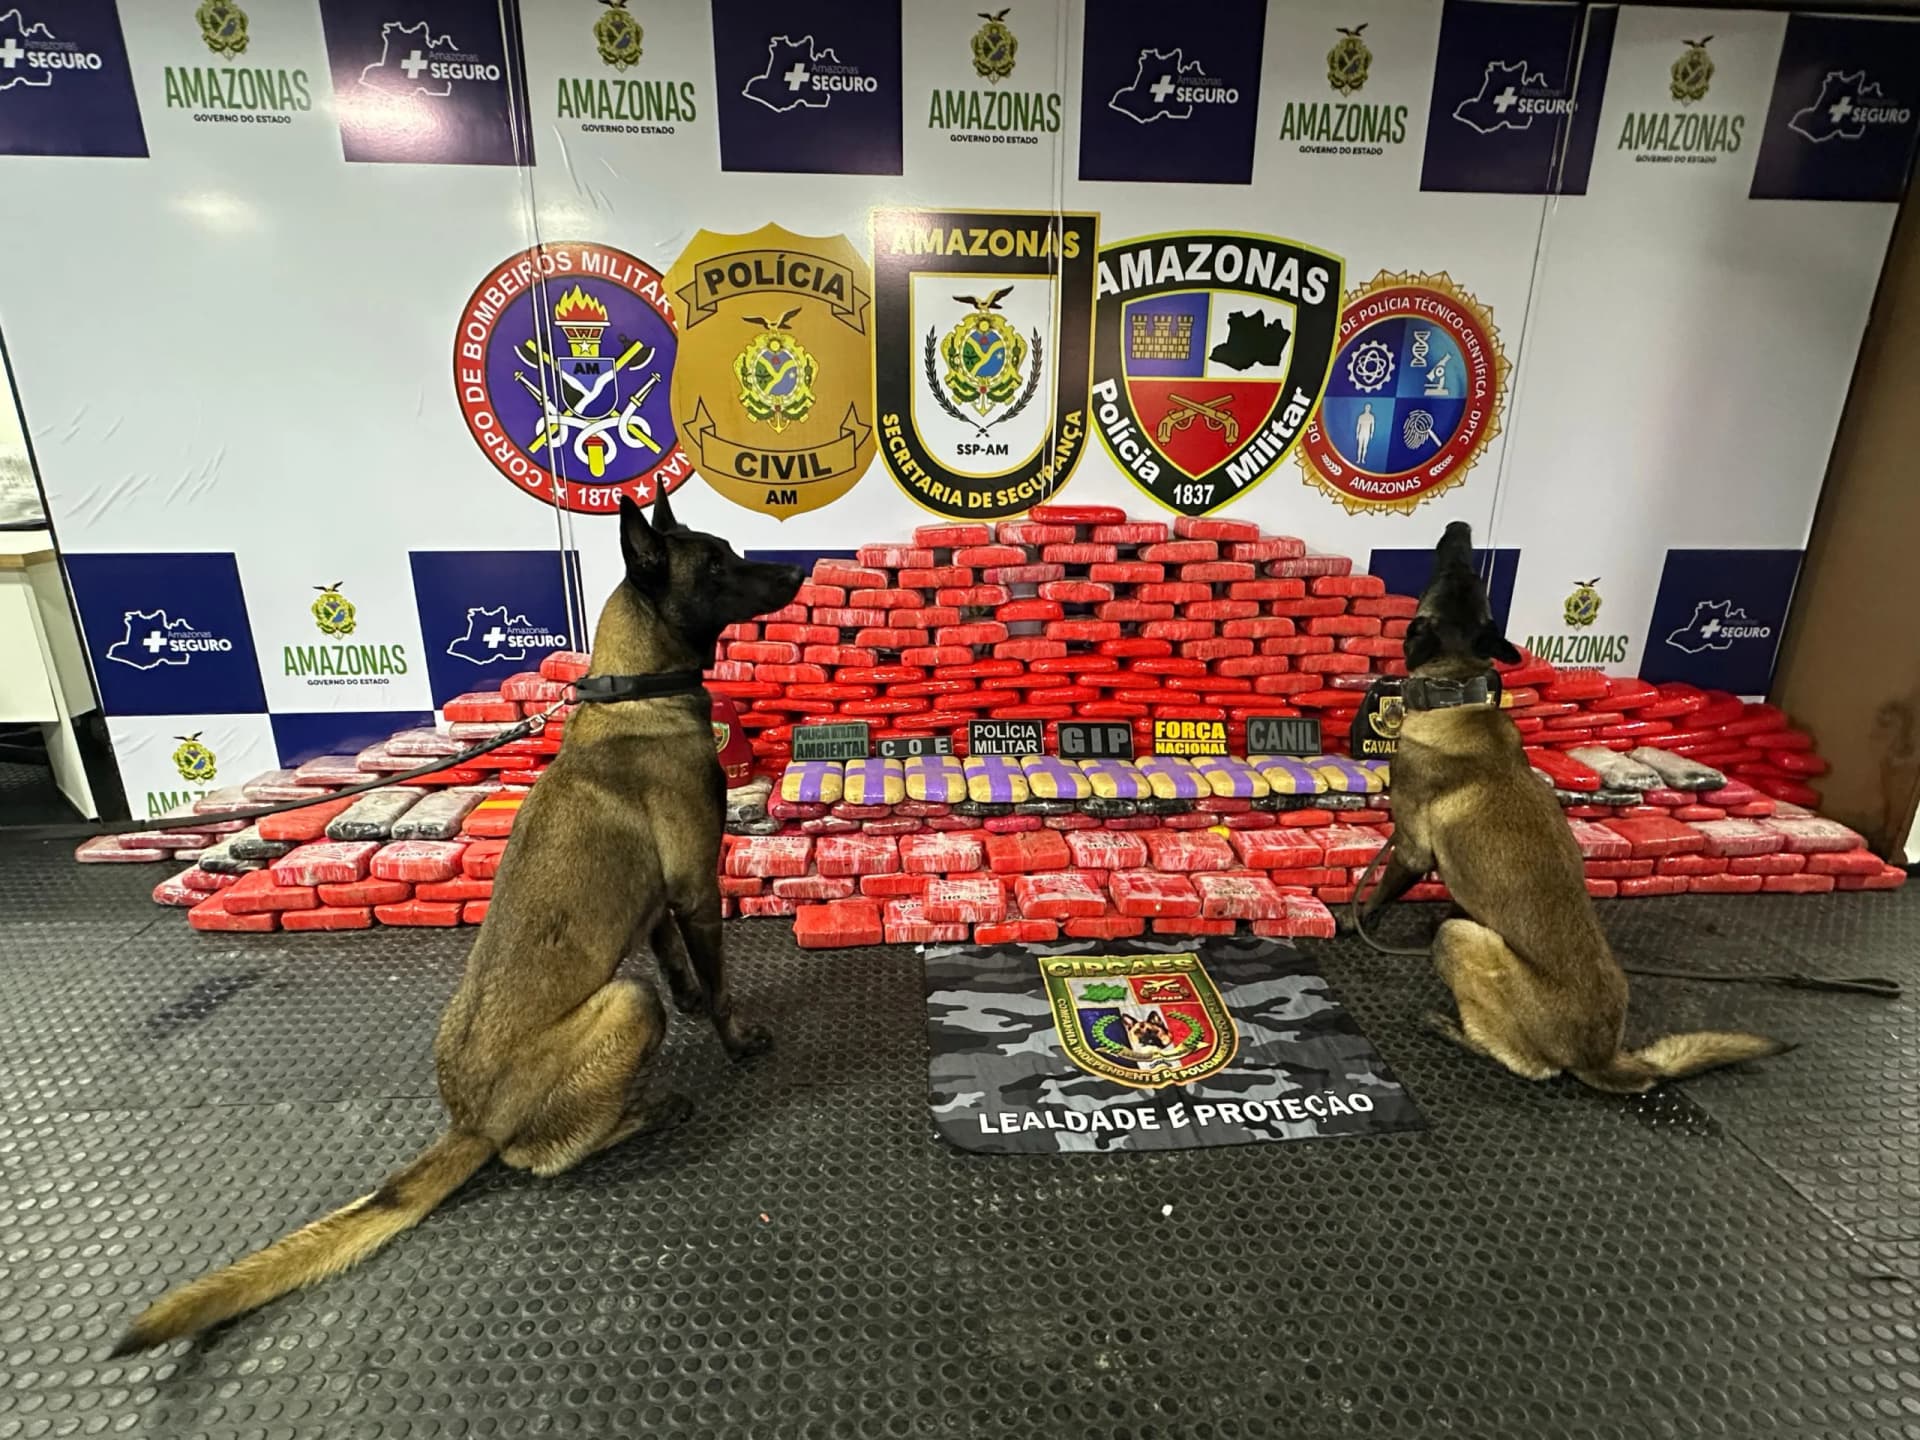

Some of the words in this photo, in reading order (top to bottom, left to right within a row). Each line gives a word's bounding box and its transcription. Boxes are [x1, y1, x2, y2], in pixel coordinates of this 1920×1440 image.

[26, 51, 102, 70] SEGURO
[429, 51, 479, 62] Amazonas
[430, 63, 500, 81] SEGURO
[811, 64, 859, 75] Amazonas
[164, 66, 312, 111] AMAZONAS
[812, 74, 878, 93] SEGURO
[557, 78, 696, 123] AMAZONAS
[1176, 87, 1239, 105] SEGURO
[1517, 97, 1578, 114] SEGURO
[194, 113, 238, 123] GOVERNO
[241, 114, 254, 123] DO
[256, 115, 291, 124] ESTADO
[929, 89, 1060, 133] AMAZONAS
[1851, 107, 1911, 123] SEGURO
[582, 123, 624, 133] GOVERNO
[626, 125, 639, 133] DO
[641, 126, 675, 135] ESTADO
[1280, 102, 1408, 145] AMAZONAS
[1618, 112, 1745, 153] AMAZONAS
[950, 134, 991, 143] GOVERNO
[993, 135, 1005, 143] DO
[1007, 135, 1038, 145] ESTADO
[1299, 145, 1337, 155] GOVERNO
[1340, 147, 1351, 155] DO
[1353, 147, 1383, 156] ESTADO
[1636, 154, 1672, 163] GOVERNO
[1674, 155, 1685, 163] DO
[1687, 155, 1716, 164] ESTADO
[890, 227, 1080, 258] AMAZONAS
[582, 250, 672, 314] MILITAR
[704, 256, 845, 301] POLÍCIA
[1096, 244, 1329, 304] AMAZONAS
[463, 251, 572, 360] BOMBEIROS
[573, 362, 600, 375] AM
[1341, 318, 1358, 335] DE
[1360, 297, 1409, 321] POLÍCIA
[1459, 410, 1482, 446] DPTC
[463, 368, 485, 403] DE
[1092, 379, 1161, 484] Polícia
[1226, 386, 1312, 488] Militar
[474, 411, 543, 488] CORPO
[882, 413, 963, 508] SECRETARIA
[968, 490, 992, 508] DE
[996, 410, 1082, 506] SEGURANÇA
[956, 444, 1009, 455] SSP-AM
[735, 451, 832, 480] CIVIL
[1173, 484, 1215, 504] 1837
[1349, 477, 1421, 493] AMAZONAS
[765, 490, 798, 505] AM
[167, 630, 212, 639] Amazonas
[507, 627, 549, 635] Amazonas
[1720, 626, 1771, 638] SEGURO
[169, 639, 232, 653] SEGURO
[508, 634, 567, 648] SEGURO
[1524, 635, 1629, 663] AMAZONAS
[284, 645, 408, 676] AMAZONAS
[974, 721, 1036, 739] POLÍCIA
[1155, 720, 1226, 741] FORÇA
[1250, 722, 1319, 752] CANIL
[796, 741, 866, 759] AMBIENTAL
[974, 740, 1038, 754] MILITAR
[1061, 728, 1129, 754] GIP
[1155, 742, 1227, 755] NACIONAL
[1363, 739, 1398, 753] CAVAL
[1057, 998, 1077, 1046] COMPANHIA
[1072, 1045, 1161, 1082] INDEPENDENTE
[979, 1107, 1161, 1134] LEALDADE
[1167, 1102, 1190, 1129] E
[1196, 1090, 1375, 1129] PROTEÇÃO
